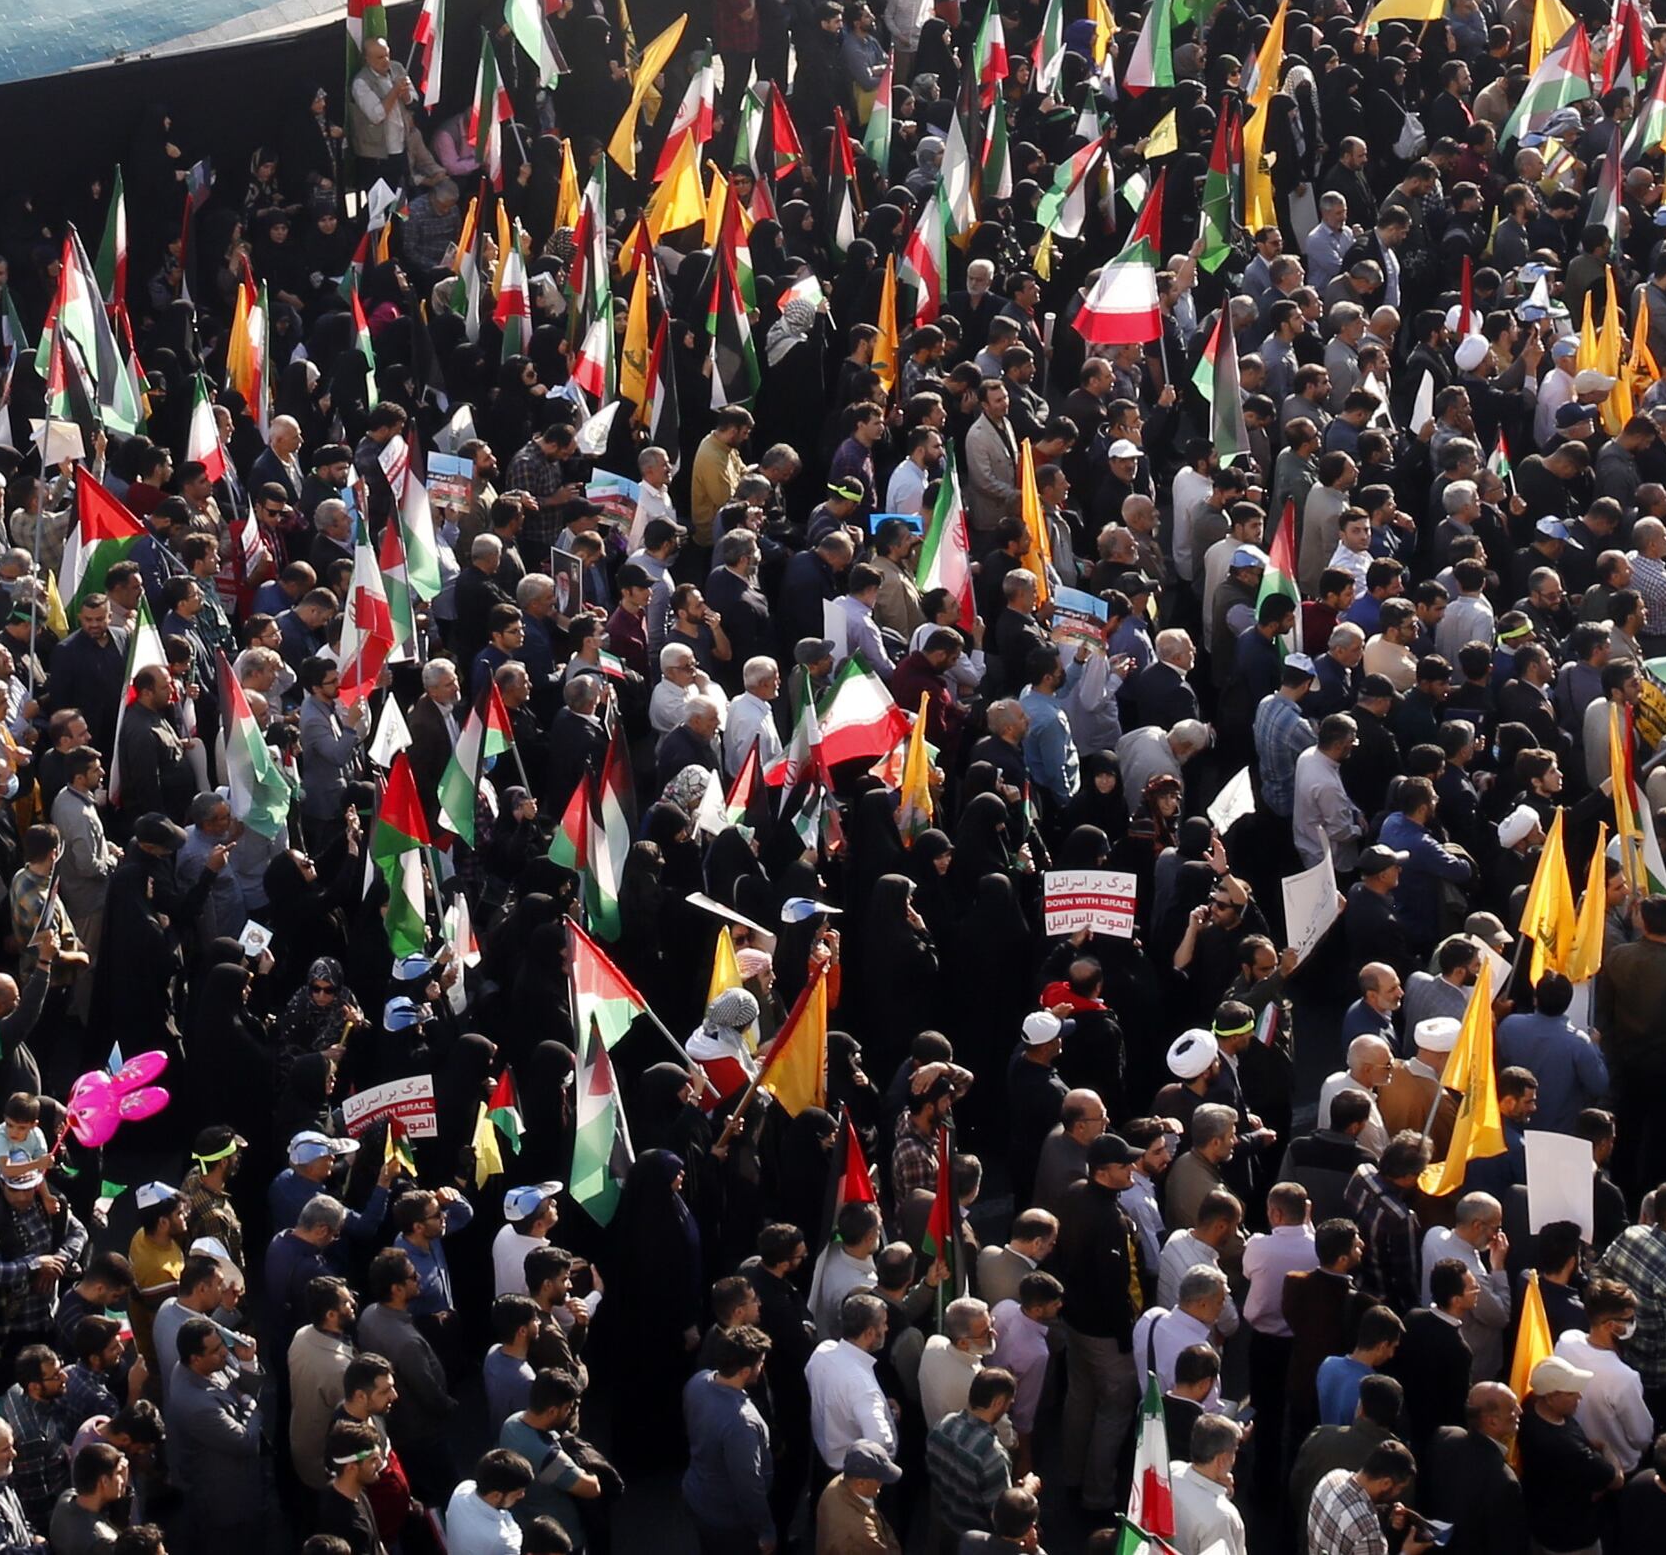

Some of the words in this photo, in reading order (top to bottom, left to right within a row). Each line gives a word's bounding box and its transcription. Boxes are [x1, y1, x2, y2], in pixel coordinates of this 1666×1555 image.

[1047, 875, 1088, 892] اسرائیل
[1091, 880, 1102, 891] بر
[1106, 876, 1133, 893] مرگ
[1045, 898, 1074, 908] DOWN
[1075, 897, 1099, 905] WITH
[1101, 898, 1134, 910] ISRAEL
[1096, 915, 1132, 930] الموت
[386, 1089, 397, 1102] بر
[401, 1081, 429, 1096] مرگ
[347, 1090, 383, 1118] اسرائیل
[347, 1117, 372, 1135] DOWN
[373, 1107, 396, 1121] WITH
[397, 1101, 433, 1112] ISRAEL
[409, 1116, 435, 1134] المو
